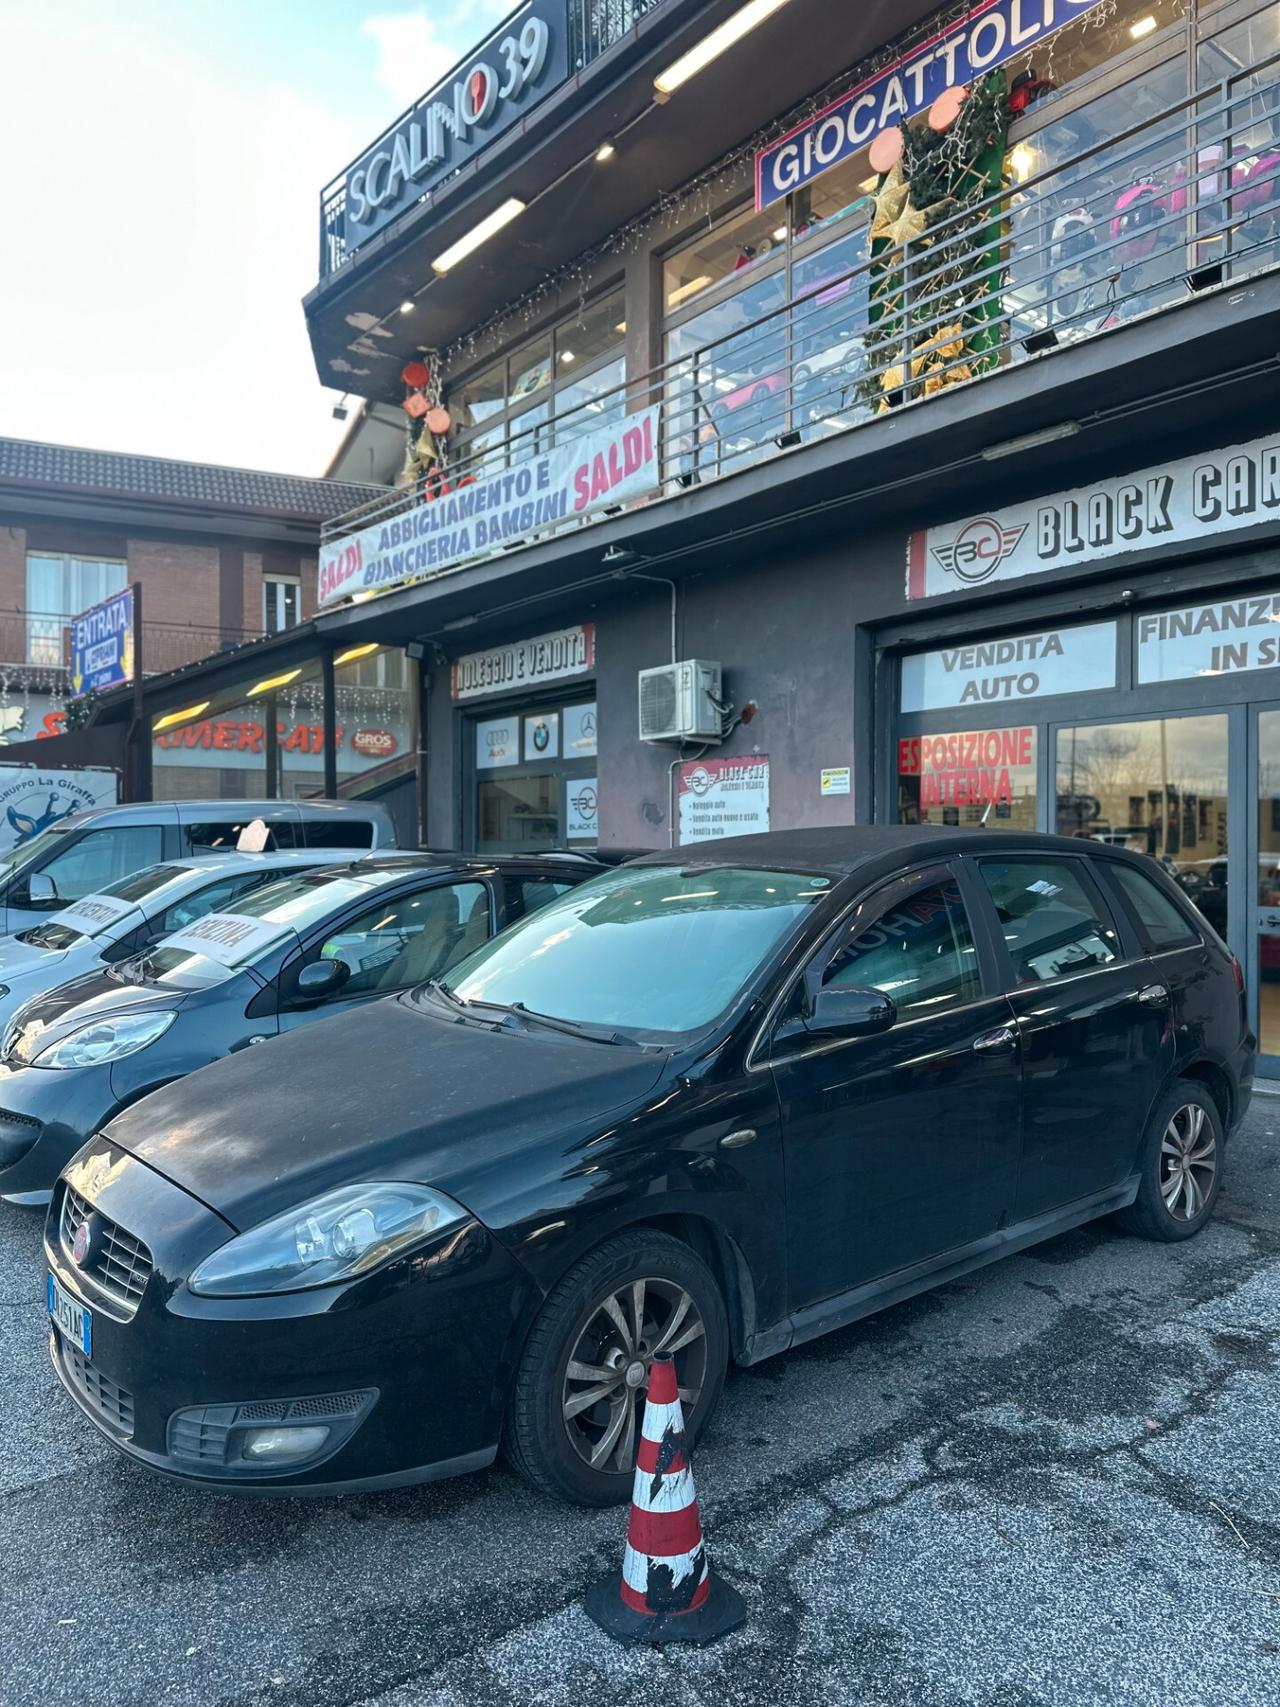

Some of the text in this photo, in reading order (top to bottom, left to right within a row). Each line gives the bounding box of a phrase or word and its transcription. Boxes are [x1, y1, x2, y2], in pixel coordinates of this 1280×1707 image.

[350, 17, 549, 225] SCALINO 39
[771, 0, 1092, 191] GIOCATTOLI
[574, 415, 654, 512] SALDI
[378, 460, 549, 551] ABBIGLIAMENTO E
[1037, 475, 1174, 559] BLACK
[363, 488, 567, 586] BIANCHERIA BAMBINI
[320, 539, 363, 602] SALDI
[77, 599, 128, 650] ENTRATA
[457, 632, 587, 691] NOLEGGIO E VENDITA
[941, 633, 1065, 673] VENDITA
[1211, 636, 1280, 671] IN S
[960, 672, 1040, 704] AUTO
[355, 733, 392, 746] GROS
[899, 728, 1033, 774] ESPOSIZIONE
[38, 777, 54, 786] La
[58, 778, 97, 807] Giraffa
[920, 769, 1012, 809] INTERNA
